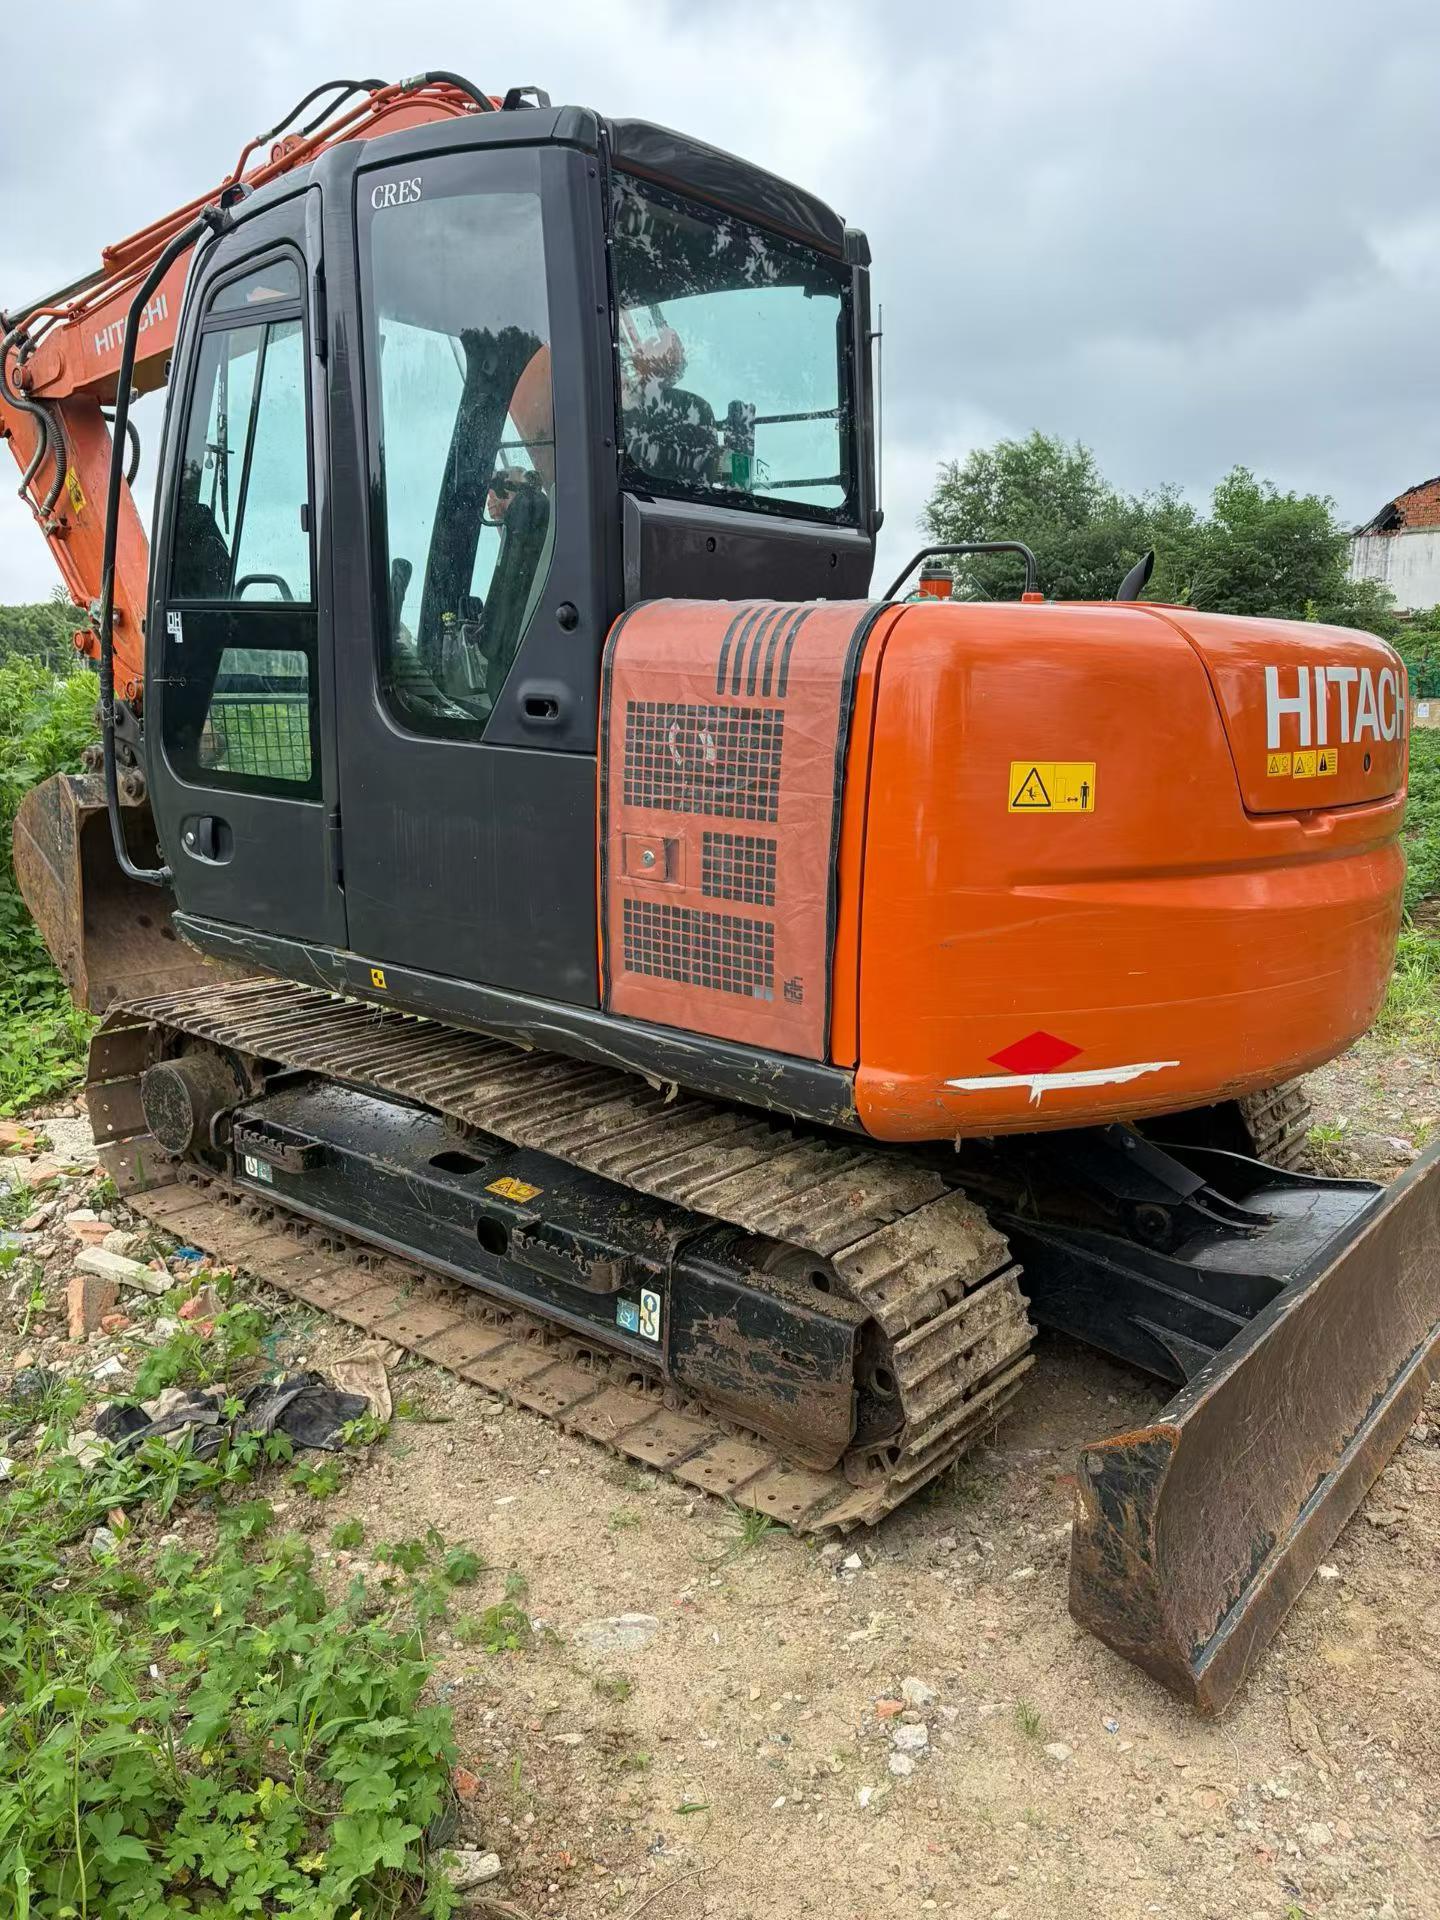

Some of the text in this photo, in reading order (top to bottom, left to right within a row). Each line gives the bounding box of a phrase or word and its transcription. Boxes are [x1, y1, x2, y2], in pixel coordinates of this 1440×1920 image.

[371, 177, 421, 209] CRES
[95, 294, 168, 356] HITCHI
[1265, 666, 1406, 749] HITACH
